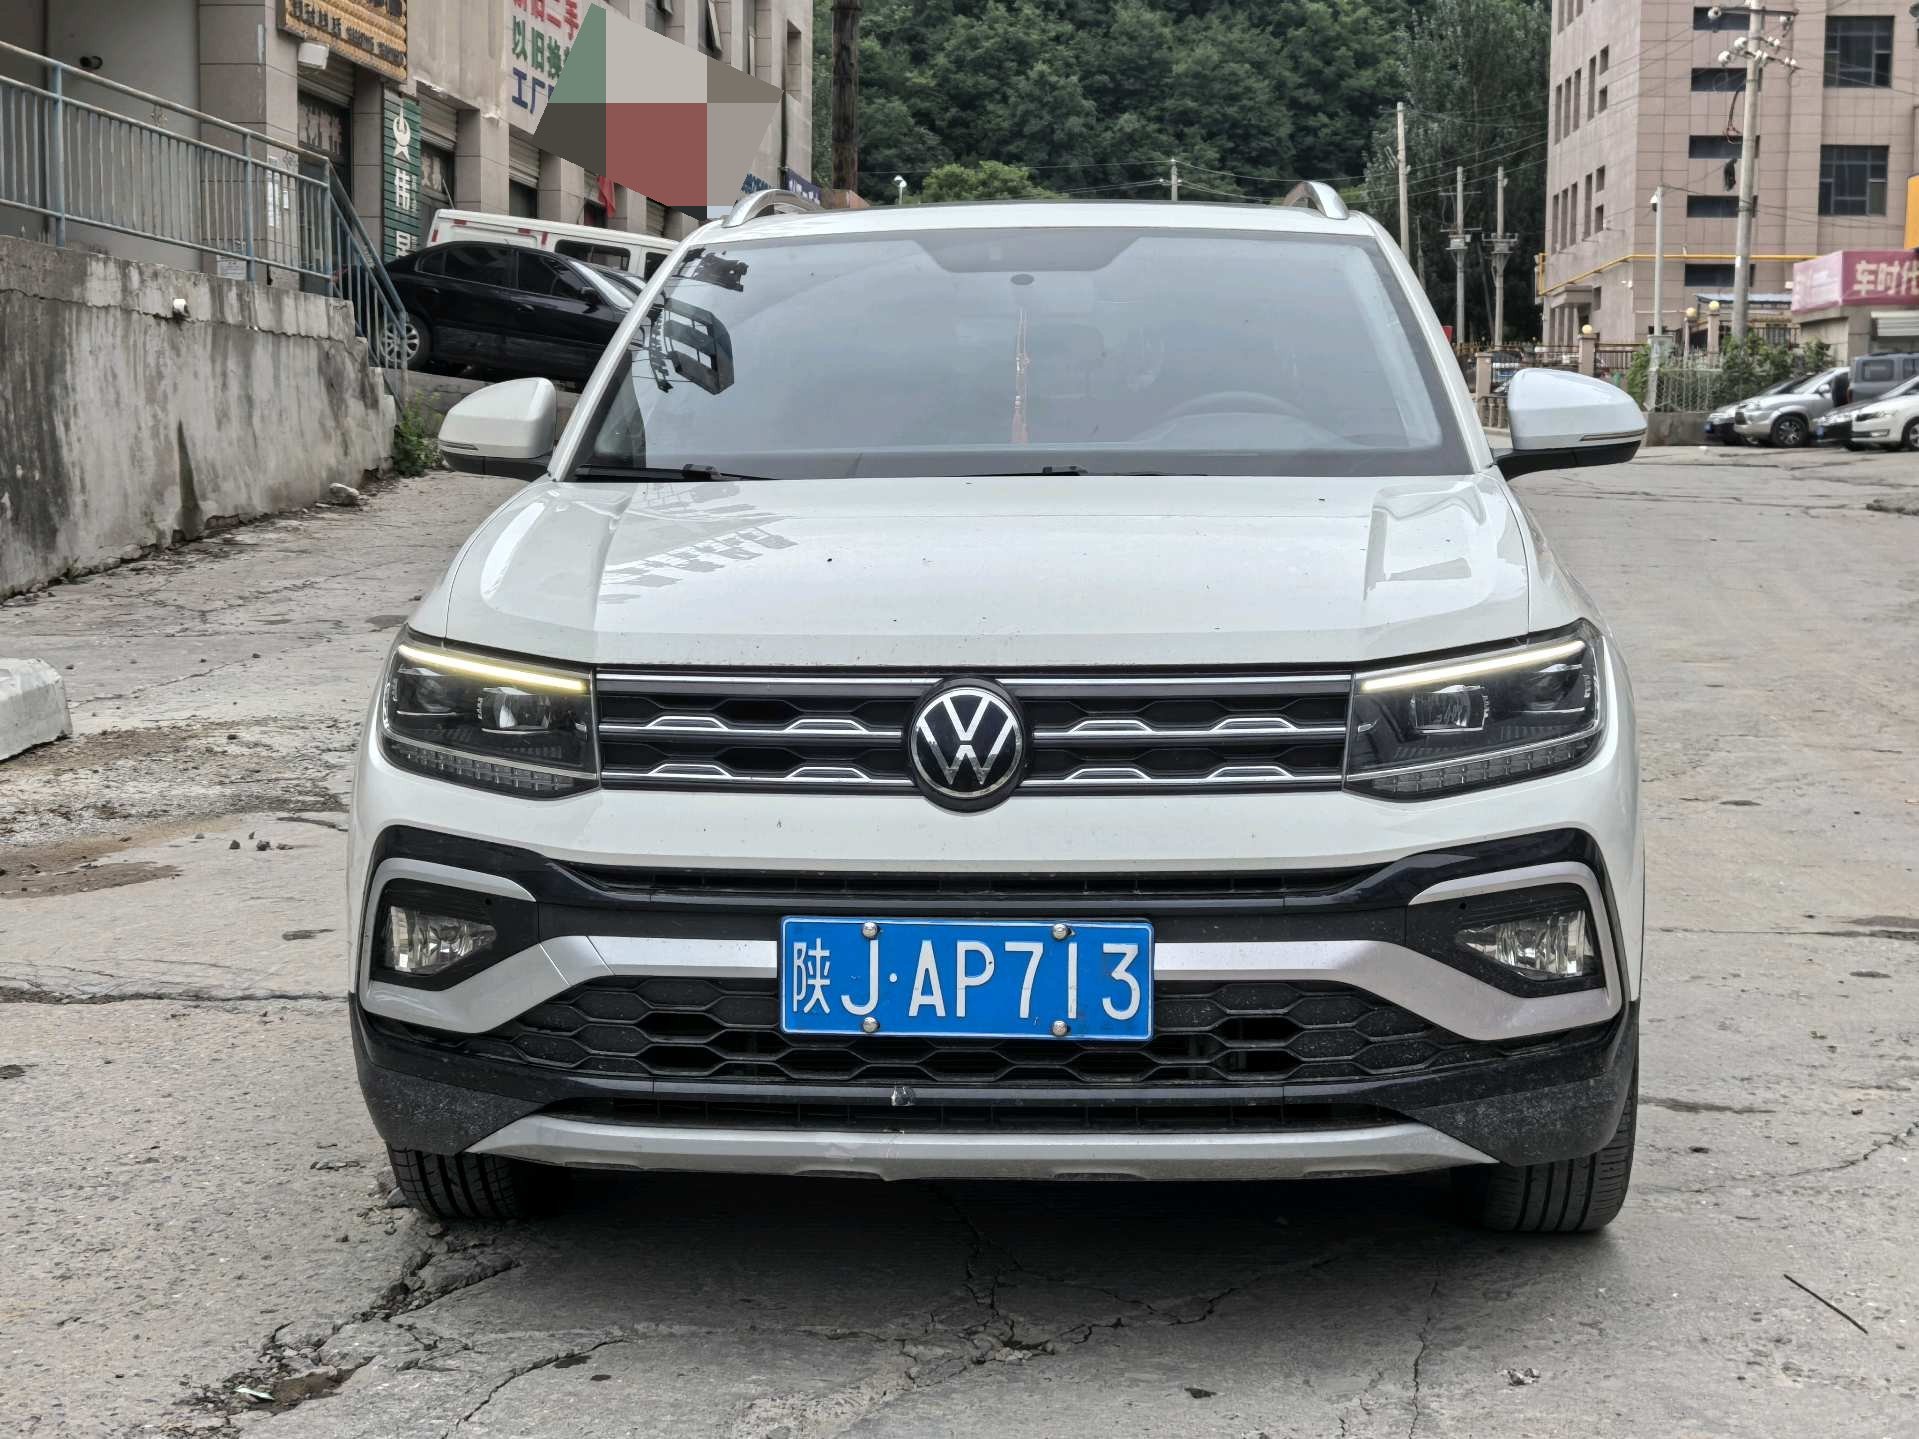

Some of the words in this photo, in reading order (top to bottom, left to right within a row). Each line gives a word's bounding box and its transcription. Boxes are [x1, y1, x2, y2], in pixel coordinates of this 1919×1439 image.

[513, 0, 579, 41] 二手
[512, 15, 571, 80] 以旧换
[511, 66, 555, 114] 工厂
